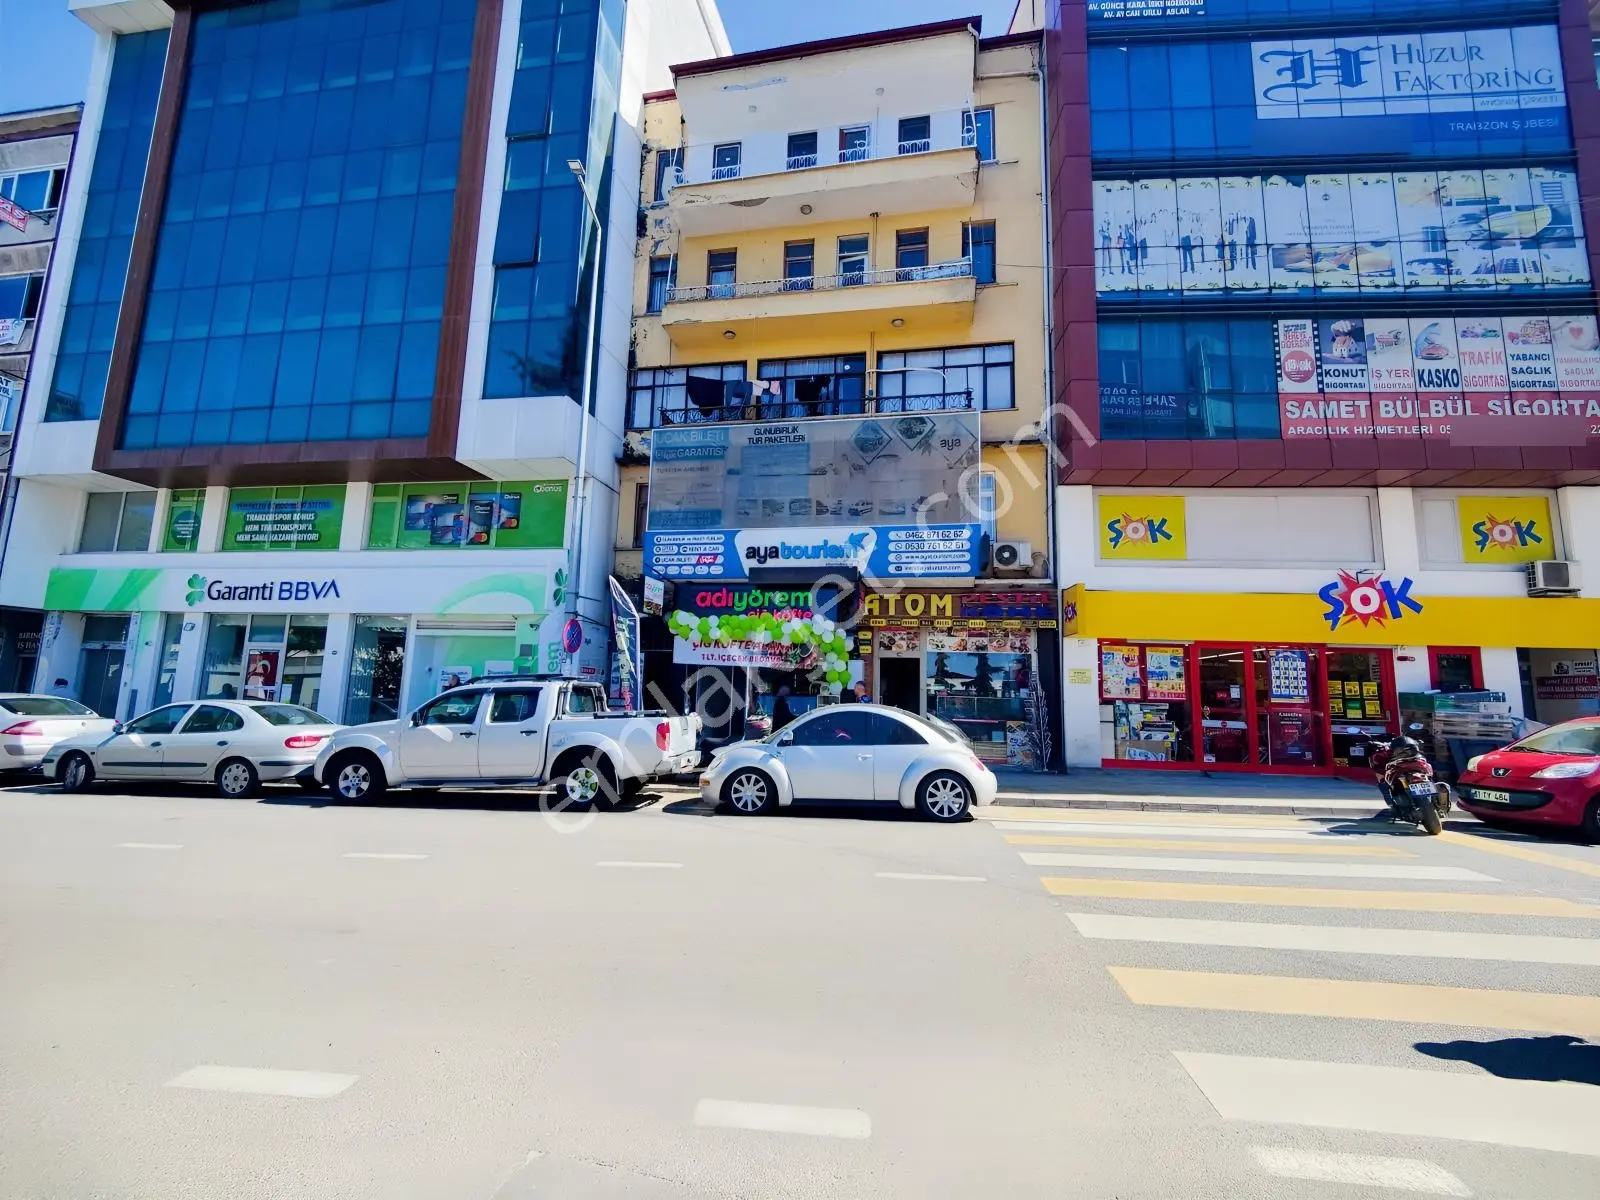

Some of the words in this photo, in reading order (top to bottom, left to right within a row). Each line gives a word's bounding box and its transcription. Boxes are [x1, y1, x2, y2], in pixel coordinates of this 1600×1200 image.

[1391, 43, 1485, 64] HUZUR
[1393, 67, 1555, 92] FAKTORİNG
[1448, 120, 1509, 131] TRABZON
[1460, 348, 1504, 365] TRAFİK
[1510, 353, 1551, 361] YABANCI
[1324, 368, 1366, 378] KONUT
[1417, 368, 1460, 388] KASKO
[1285, 400, 1371, 419] SAMET
[1379, 396, 1481, 419] BÜLBÜL
[1288, 426, 1350, 435] ARACILIK
[940, 438, 962, 451] aya
[1107, 514, 1173, 550] ŞOK
[1472, 518, 1543, 553] ŞOK
[207, 580, 274, 601] Garanti
[278, 579, 340, 601] BBVA
[864, 593, 953, 617] ATOM
[1318, 575, 1424, 632] ŞOK
